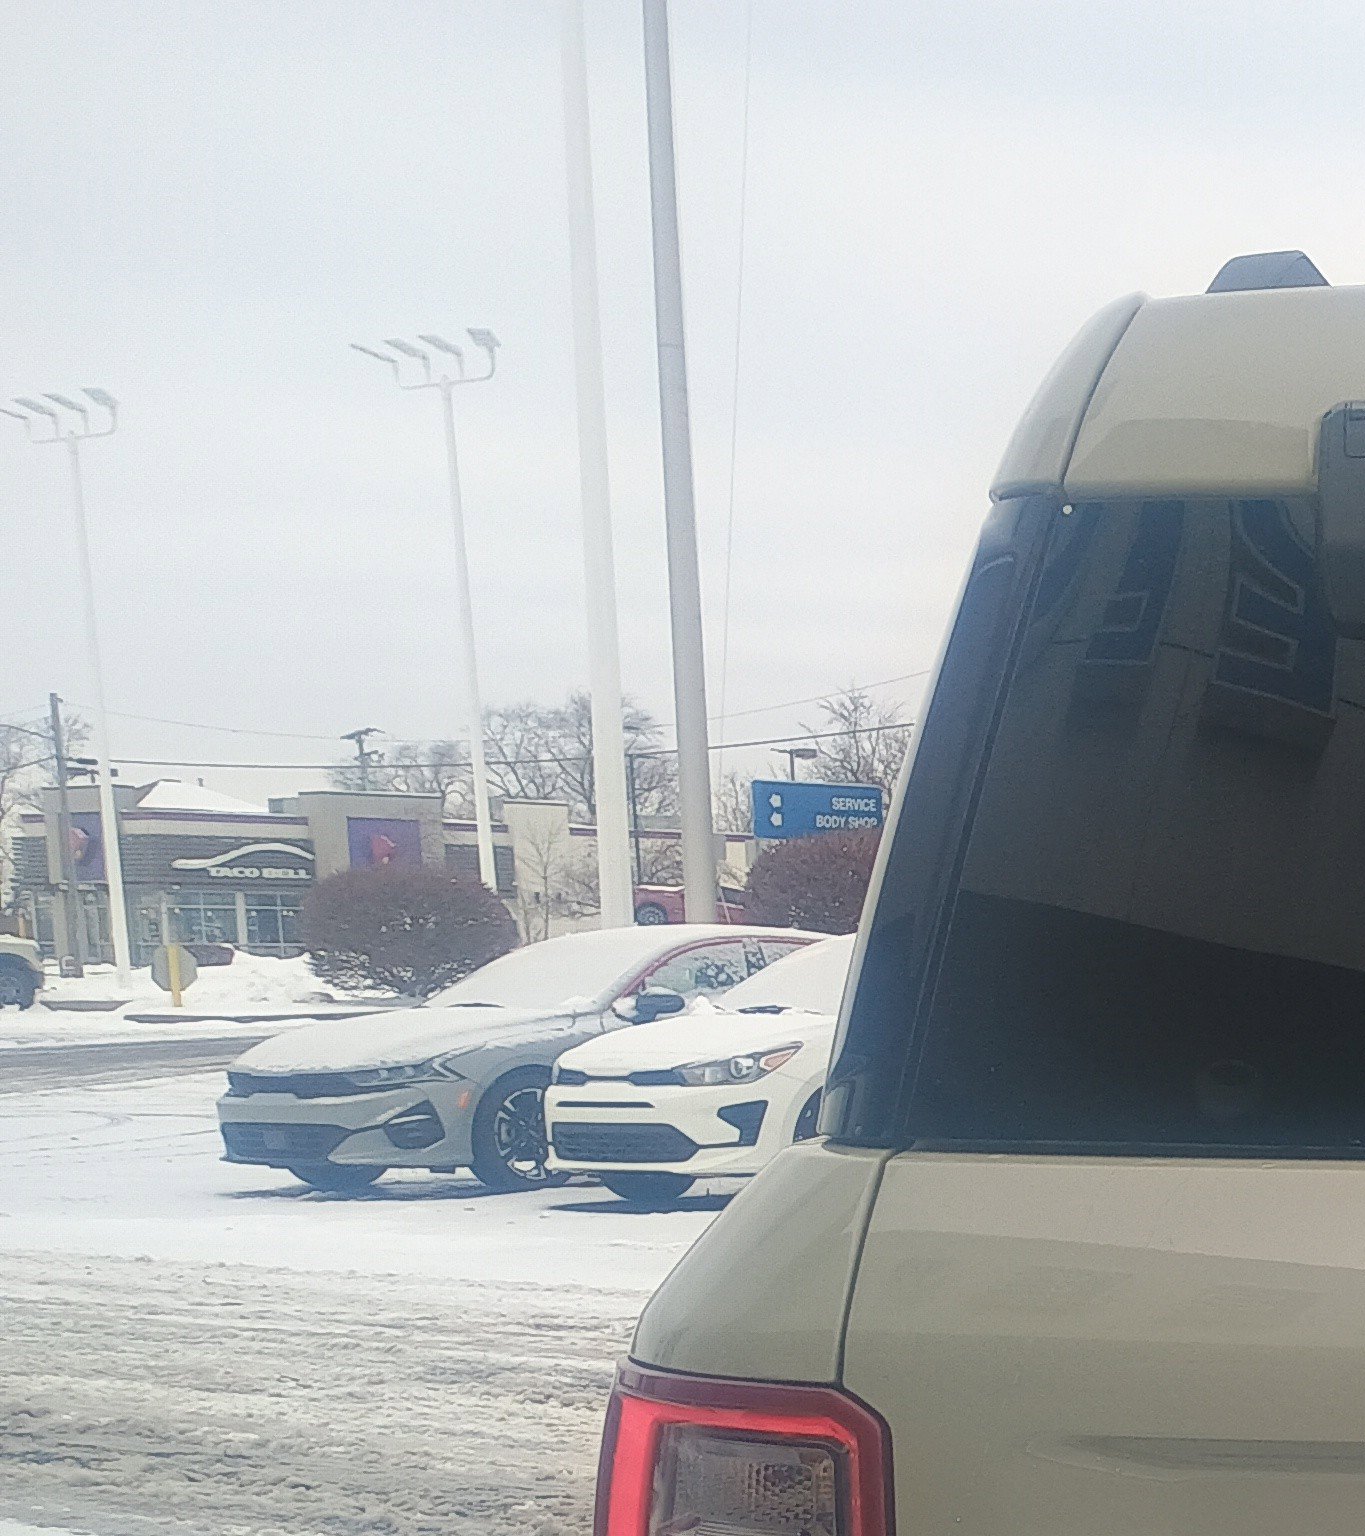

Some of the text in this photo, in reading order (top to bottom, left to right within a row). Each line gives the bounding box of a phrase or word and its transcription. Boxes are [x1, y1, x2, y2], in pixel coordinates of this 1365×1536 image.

[831, 797, 877, 811] SERVICE
[815, 815, 878, 829] BODY SHOP
